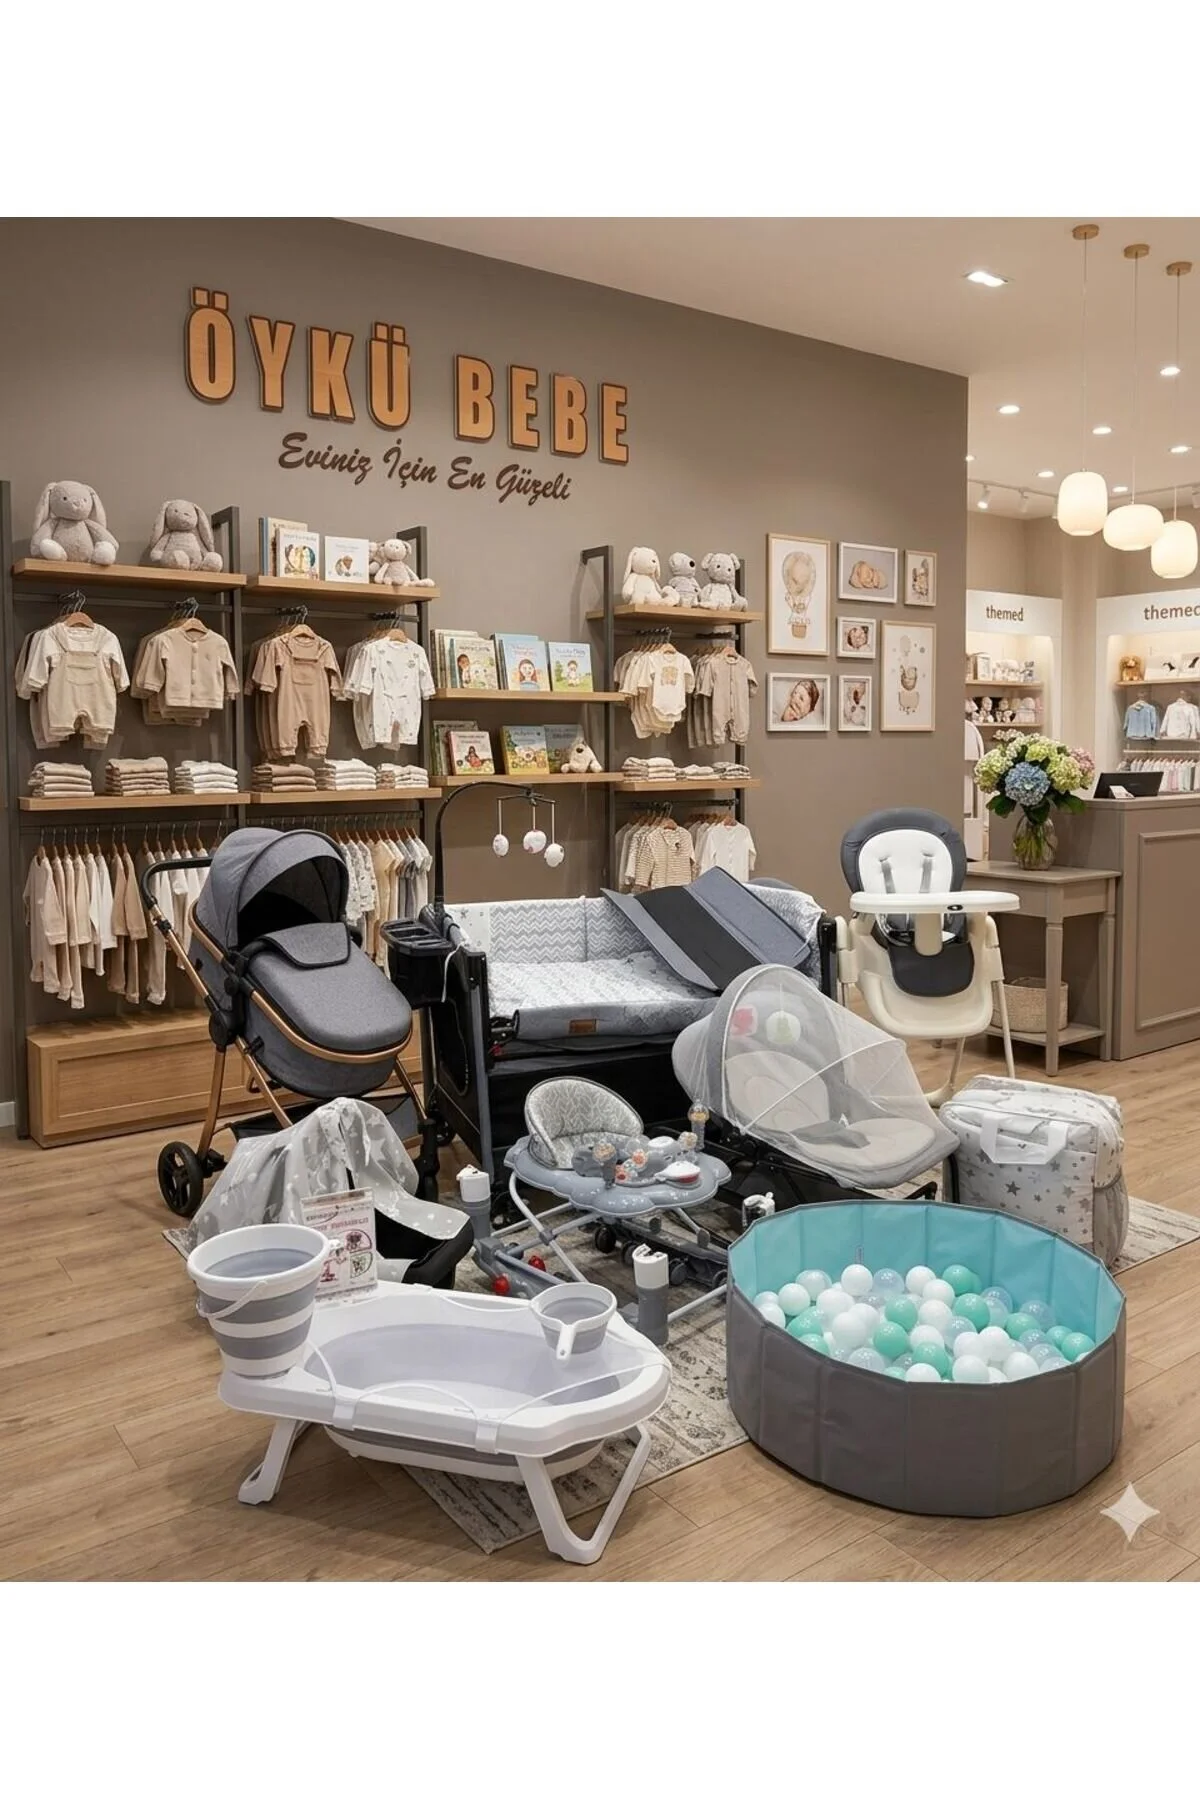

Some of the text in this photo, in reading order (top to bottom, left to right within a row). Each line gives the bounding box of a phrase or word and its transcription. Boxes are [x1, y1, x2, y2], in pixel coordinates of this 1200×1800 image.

[185, 287, 629, 464] ÖYKÜ BEBE
[278, 432, 572, 506] Eviniz İçin En Güzeli
[986, 604, 1024, 621] themed
